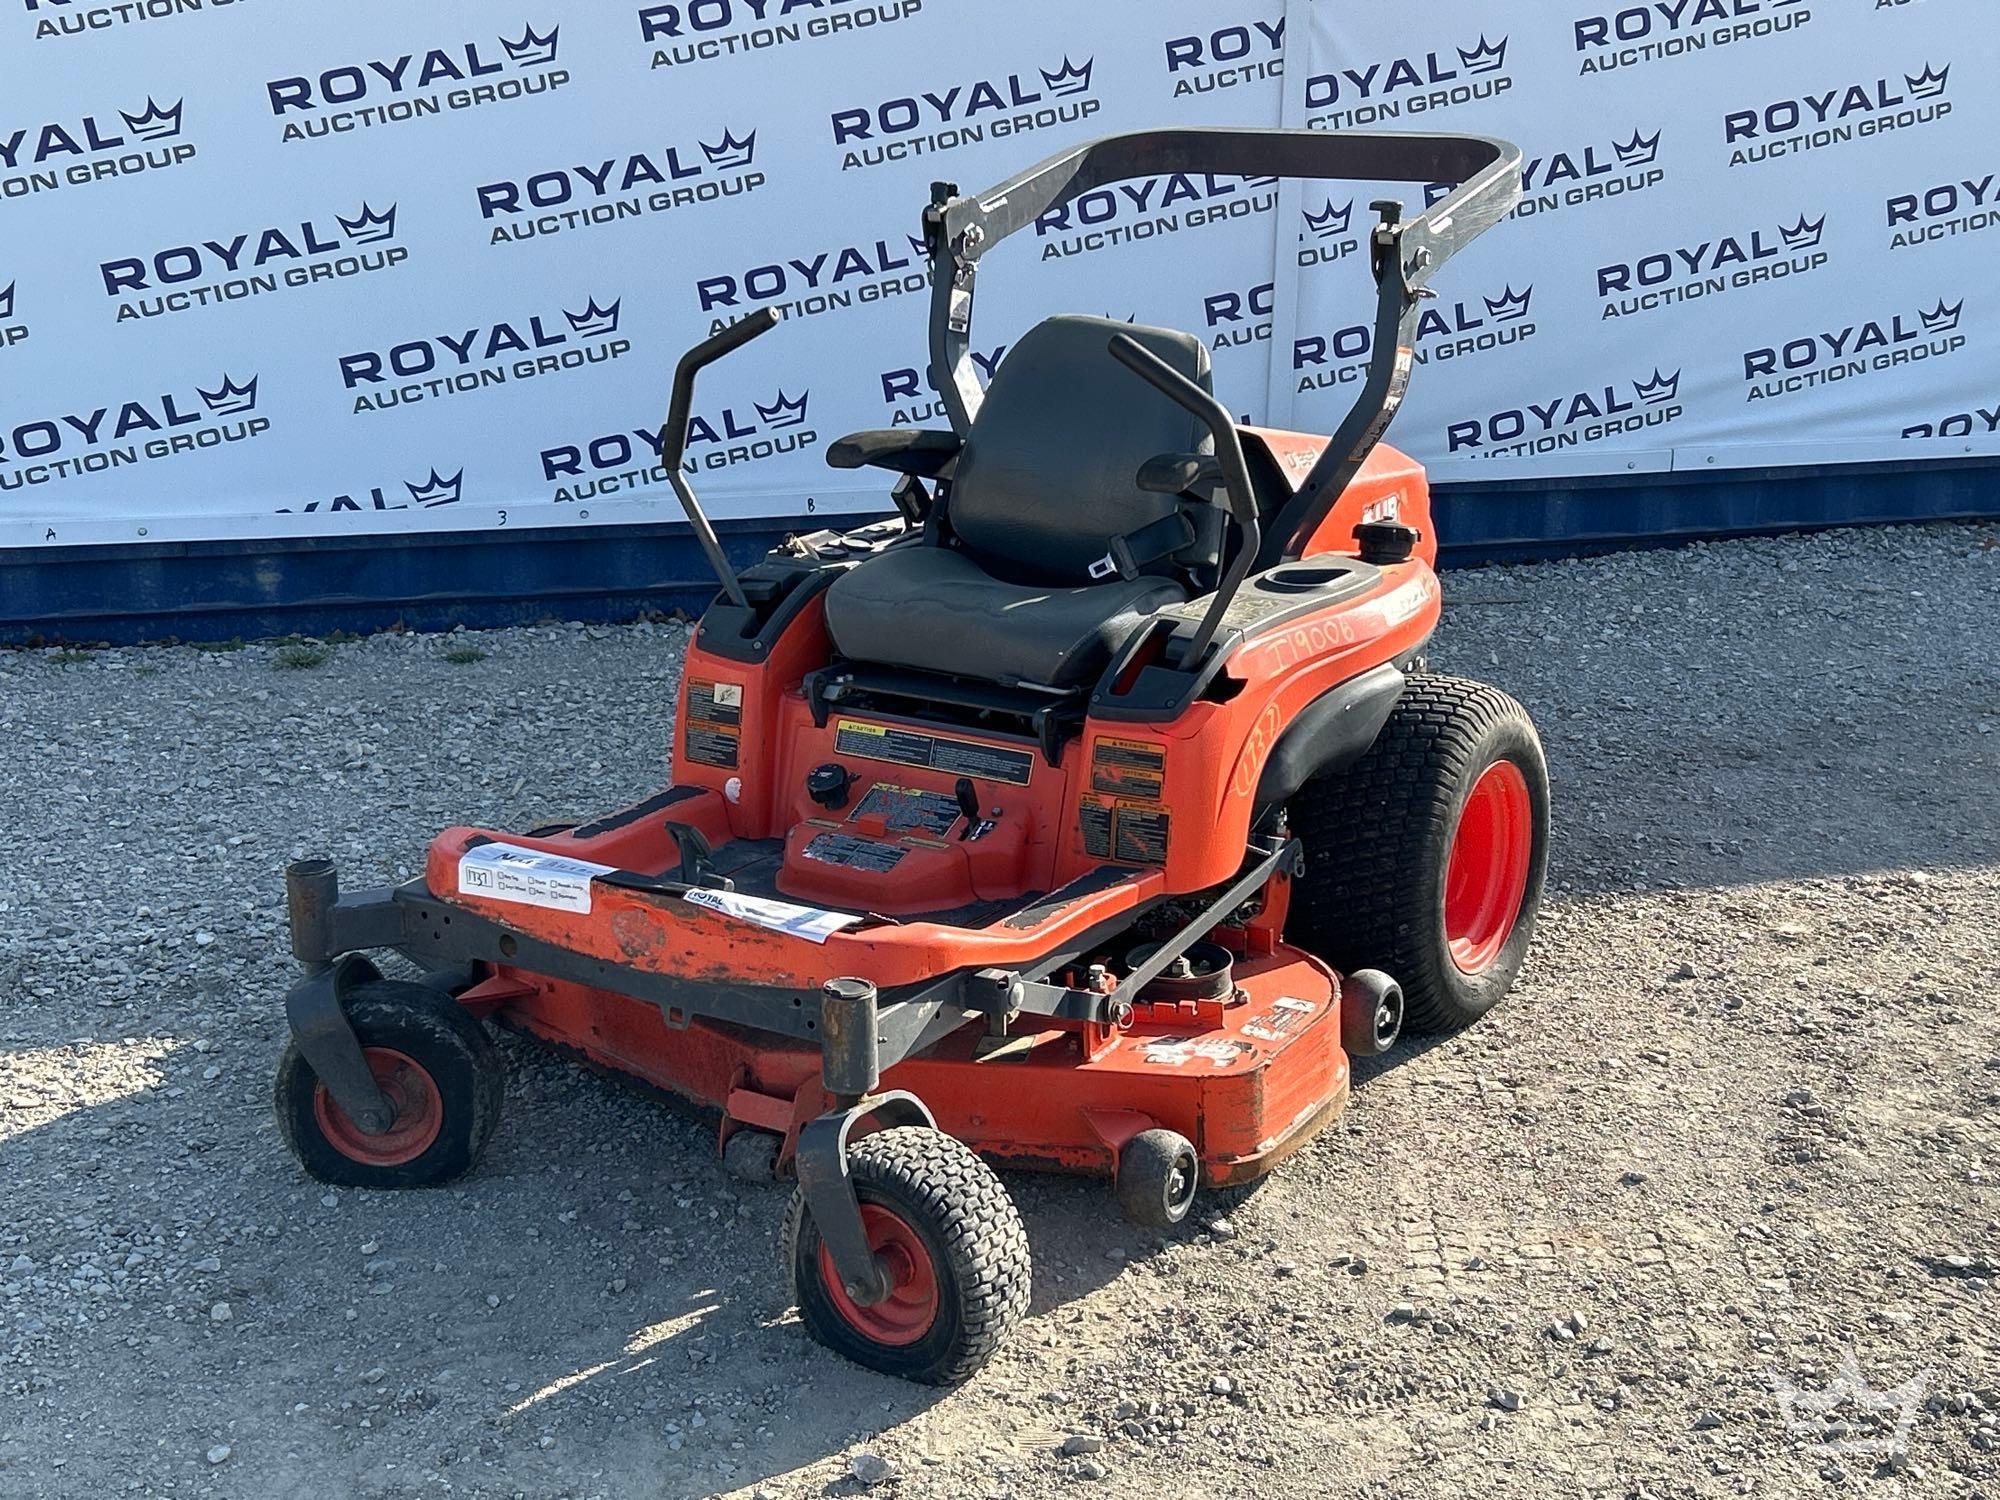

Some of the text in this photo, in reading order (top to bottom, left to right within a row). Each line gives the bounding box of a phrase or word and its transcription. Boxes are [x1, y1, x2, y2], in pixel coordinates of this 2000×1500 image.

[651, 0, 921, 69] AUCTION GROUP
[1580, 11, 1810, 76] AUCTION GROUP
[267, 43, 503, 115] ROYAL
[283, 71, 569, 143] AUCTION GROUP
[831, 75, 1041, 145] ROYAL
[1407, 77, 1511, 113] GROUP
[1725, 79, 1903, 143] ROYAL
[67, 144, 195, 184] GROUP
[842, 100, 1100, 171] AUCTION GROUP
[1729, 102, 1951, 167] AUCTION GROUP
[477, 147, 701, 218] ROYAL
[491, 173, 764, 245] AUCTION GROUP
[1035, 173, 1234, 236] ROYAL
[1566, 169, 1663, 205] GROUP
[1887, 175, 2000, 227] ROY
[100, 222, 340, 296] ROYAL
[1042, 191, 1278, 261] AUCTION GROU
[117, 247, 408, 322] AUCTION GROUP
[697, 241, 909, 312] ROYAL
[1597, 231, 1778, 297] ROYAL
[1602, 252, 1827, 320] AUCTION GROUP
[339, 316, 566, 388] ROYAL
[1294, 303, 1483, 370] ROAL
[1436, 324, 1535, 360] GROUP
[1744, 316, 1917, 380] ROYAL
[1747, 336, 1965, 402] AUCTION GROUP
[354, 340, 630, 414] AUCTION GROUP
[0, 395, 201, 463] OYAL
[145, 418, 270, 458] GROUP
[705, 431, 817, 469] GROUP
[1448, 386, 1633, 452] ROYAL
[1585, 405, 1682, 441] GROUP
[45, 527, 57, 542] A
